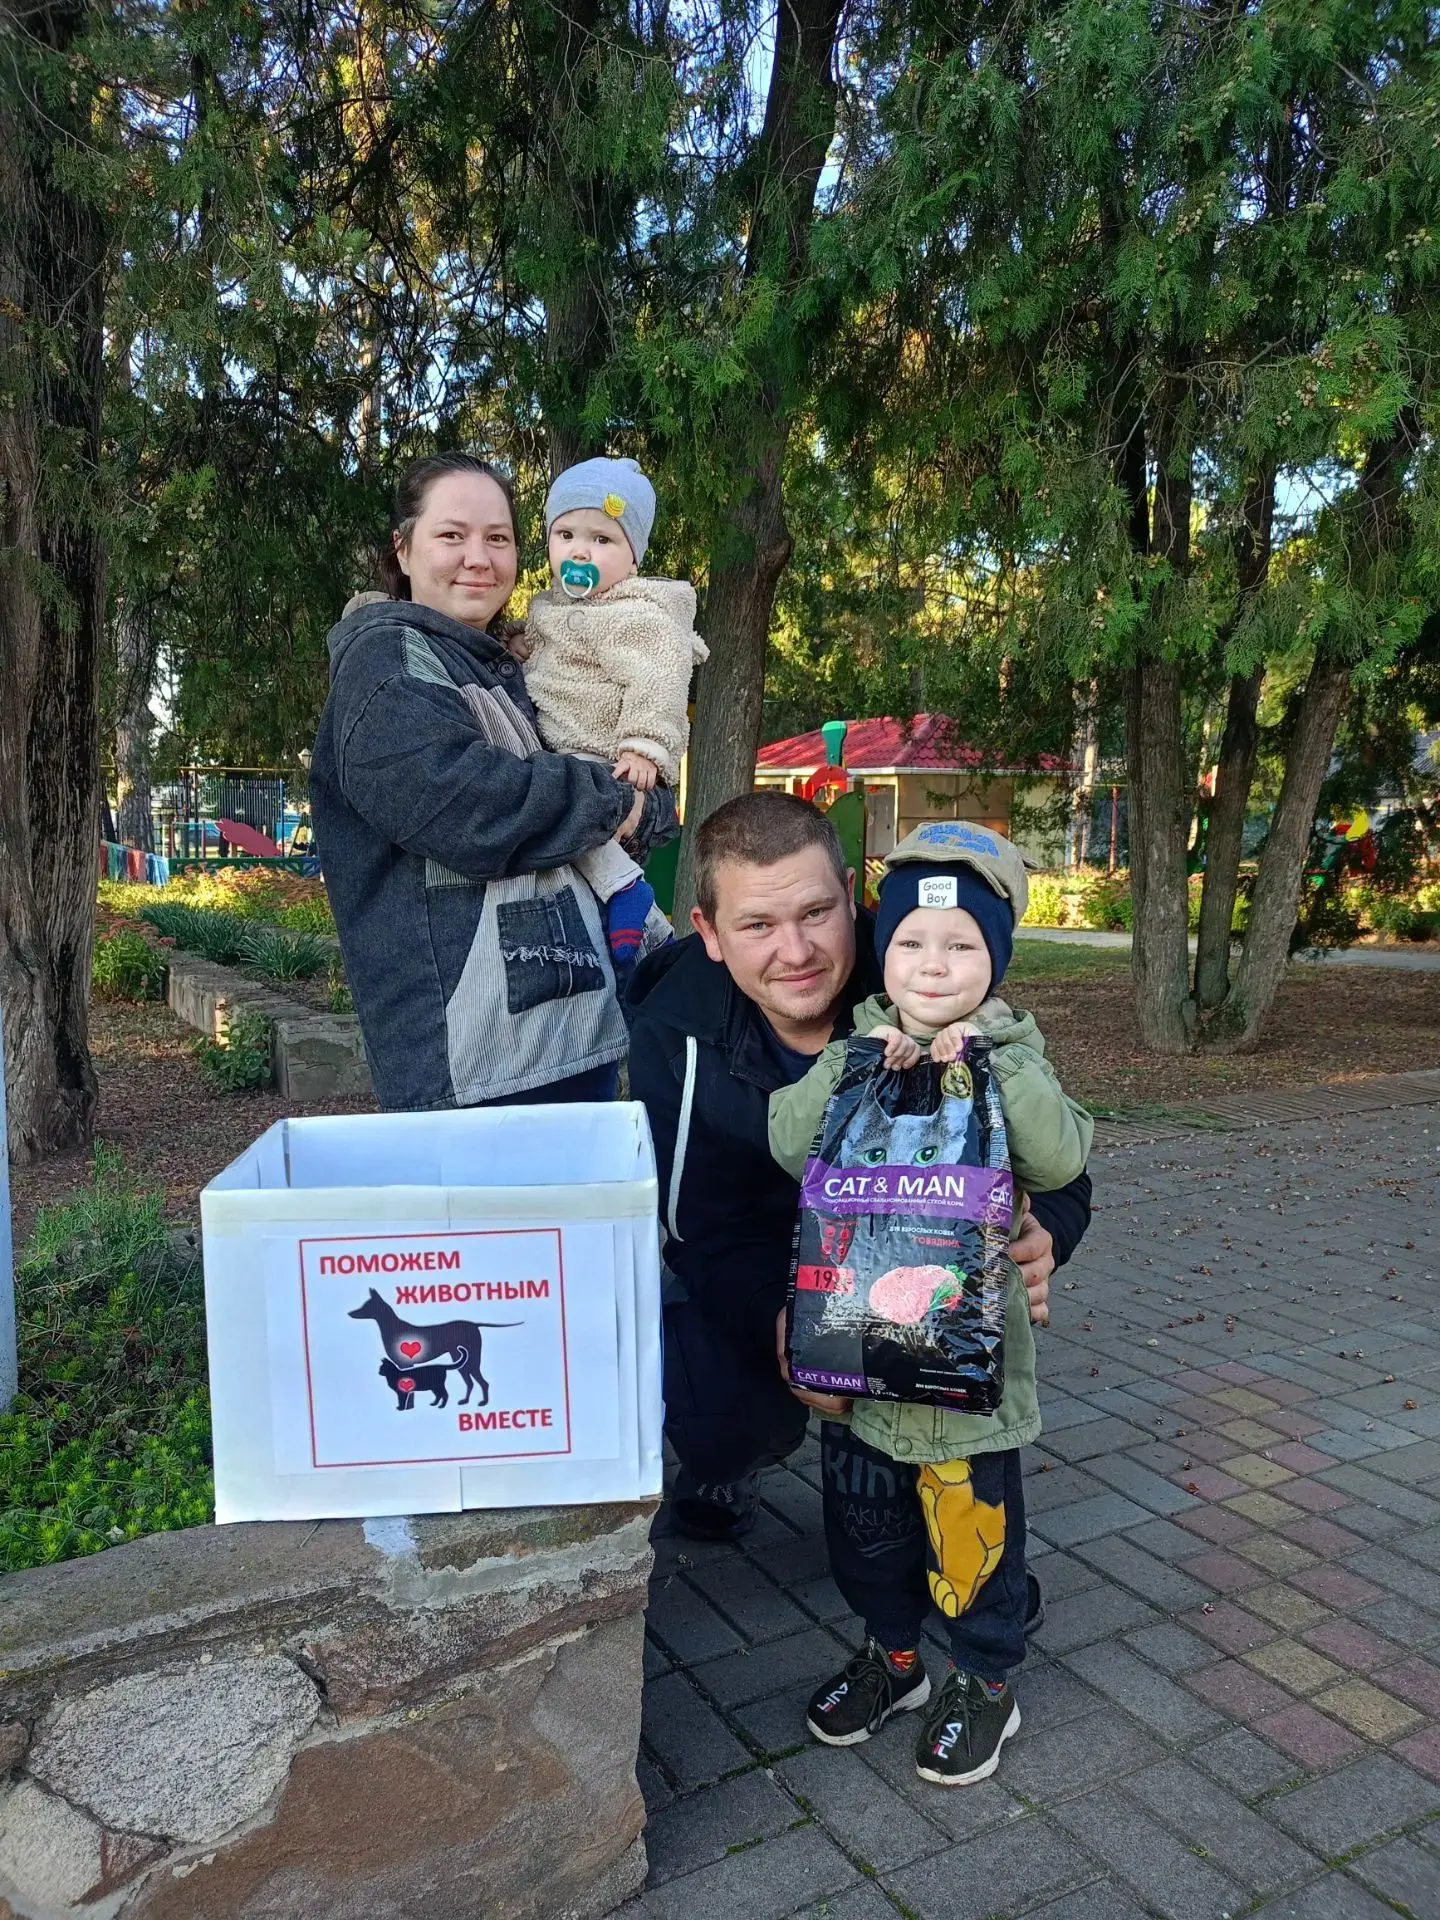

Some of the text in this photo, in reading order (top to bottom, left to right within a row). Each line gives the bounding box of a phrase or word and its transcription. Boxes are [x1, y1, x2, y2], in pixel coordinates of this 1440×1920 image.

[923, 881, 952, 892] Good
[926, 893, 948, 906] Boy
[824, 1175, 965, 1199] CAT & MAN
[990, 1188, 1009, 1205] CAT
[319, 1250, 461, 1275] ПОМОЖЕМ
[396, 1279, 550, 1305] ЖИВОТНЫМ
[797, 1371, 818, 1383] CAT
[820, 1375, 828, 1384] &
[831, 1376, 861, 1387] MAN
[458, 1408, 553, 1431] ВМЕСТЕ
[933, 1721, 963, 1759] FILA
